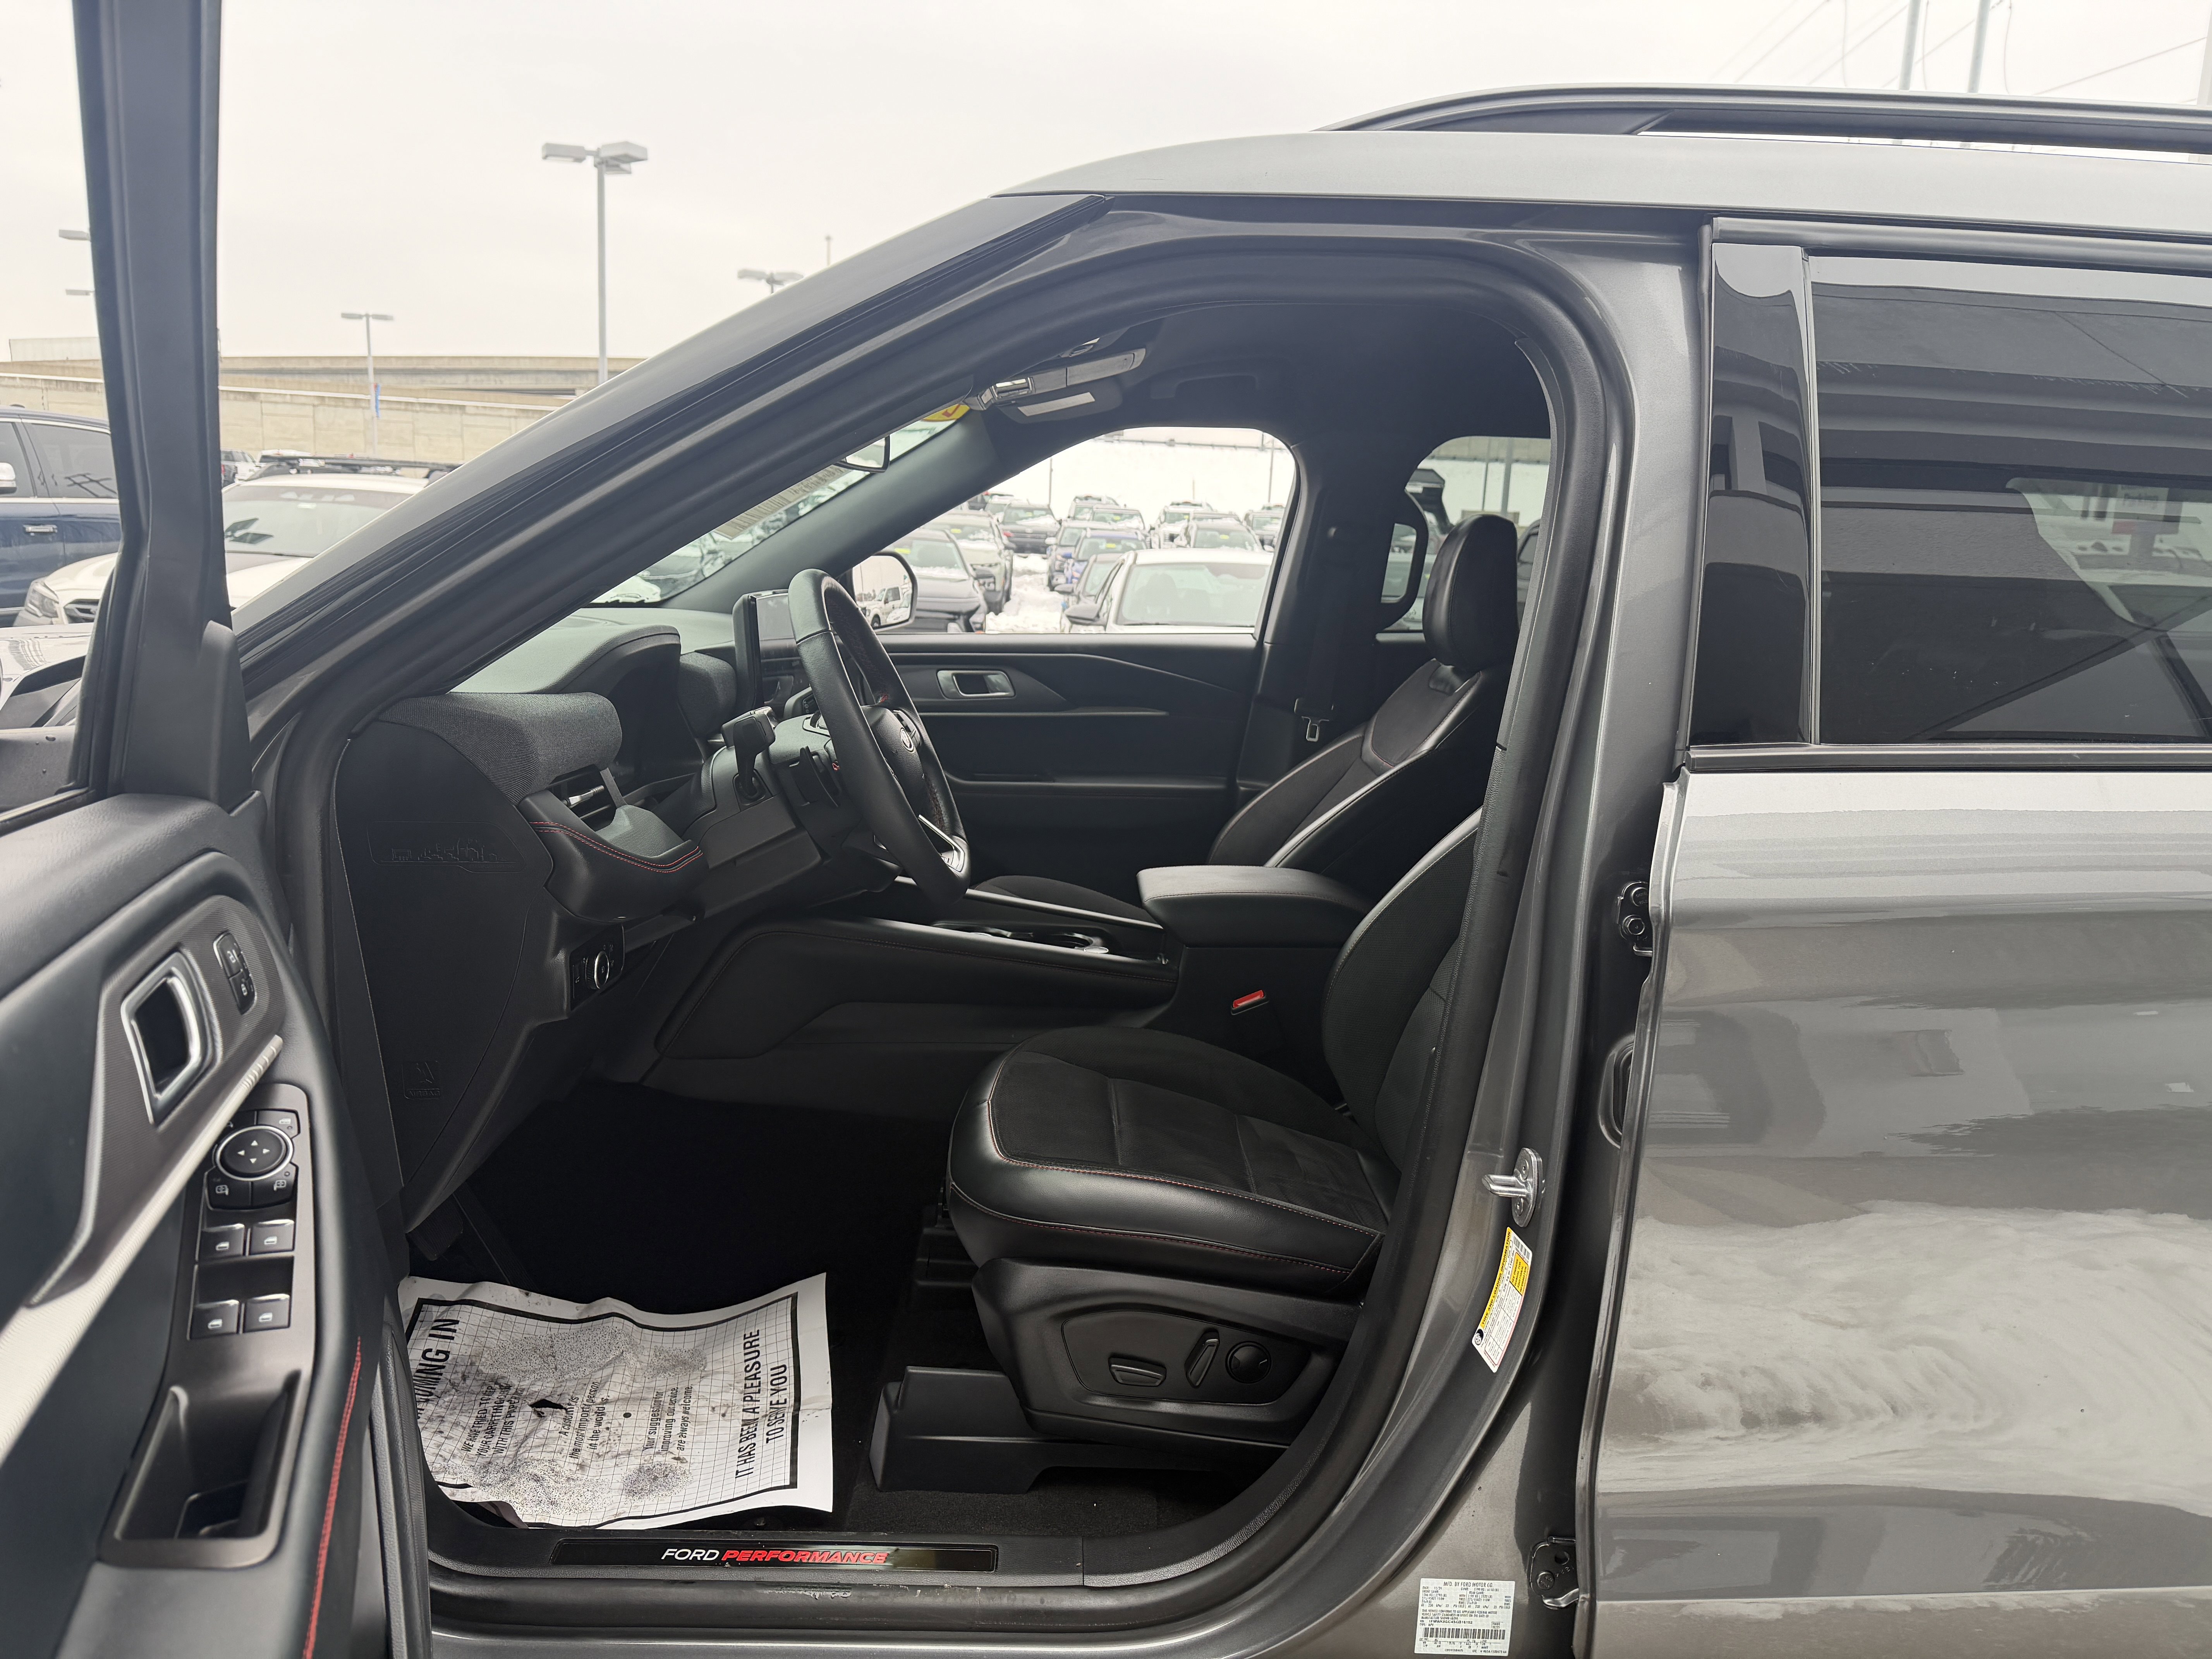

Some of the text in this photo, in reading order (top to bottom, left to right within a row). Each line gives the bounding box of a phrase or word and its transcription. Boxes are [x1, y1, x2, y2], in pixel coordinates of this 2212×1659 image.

[1492, 1272, 1502, 1298] LOADING
[1500, 1230, 1510, 1272] INFORMATION
[429, 1319, 459, 1340] IN
[743, 1329, 761, 1402] PLEASURE
[479, 1397, 490, 1407] TO
[766, 1364, 787, 1444] TO SERVE YOU
[472, 1409, 487, 1428] TRIED
[568, 1448, 580, 1459] the
[586, 1382, 600, 1403] person
[677, 1384, 692, 1451] are always welcome.
[466, 1429, 480, 1442] HAVE
[500, 1421, 514, 1436] THIS
[587, 1430, 600, 1441] the
[658, 1419, 675, 1451] improving
[667, 1407, 675, 1416] our
[739, 1417, 759, 1443] BEEN
[461, 1441, 473, 1452] WE
[476, 1441, 491, 1456] YOUR
[493, 1437, 508, 1454] WITH
[642, 1437, 655, 1451] Your
[737, 1442, 756, 1466] HAS
[735, 1467, 754, 1479] IT
[661, 1549, 889, 1564] FORD PERFORMANCE
